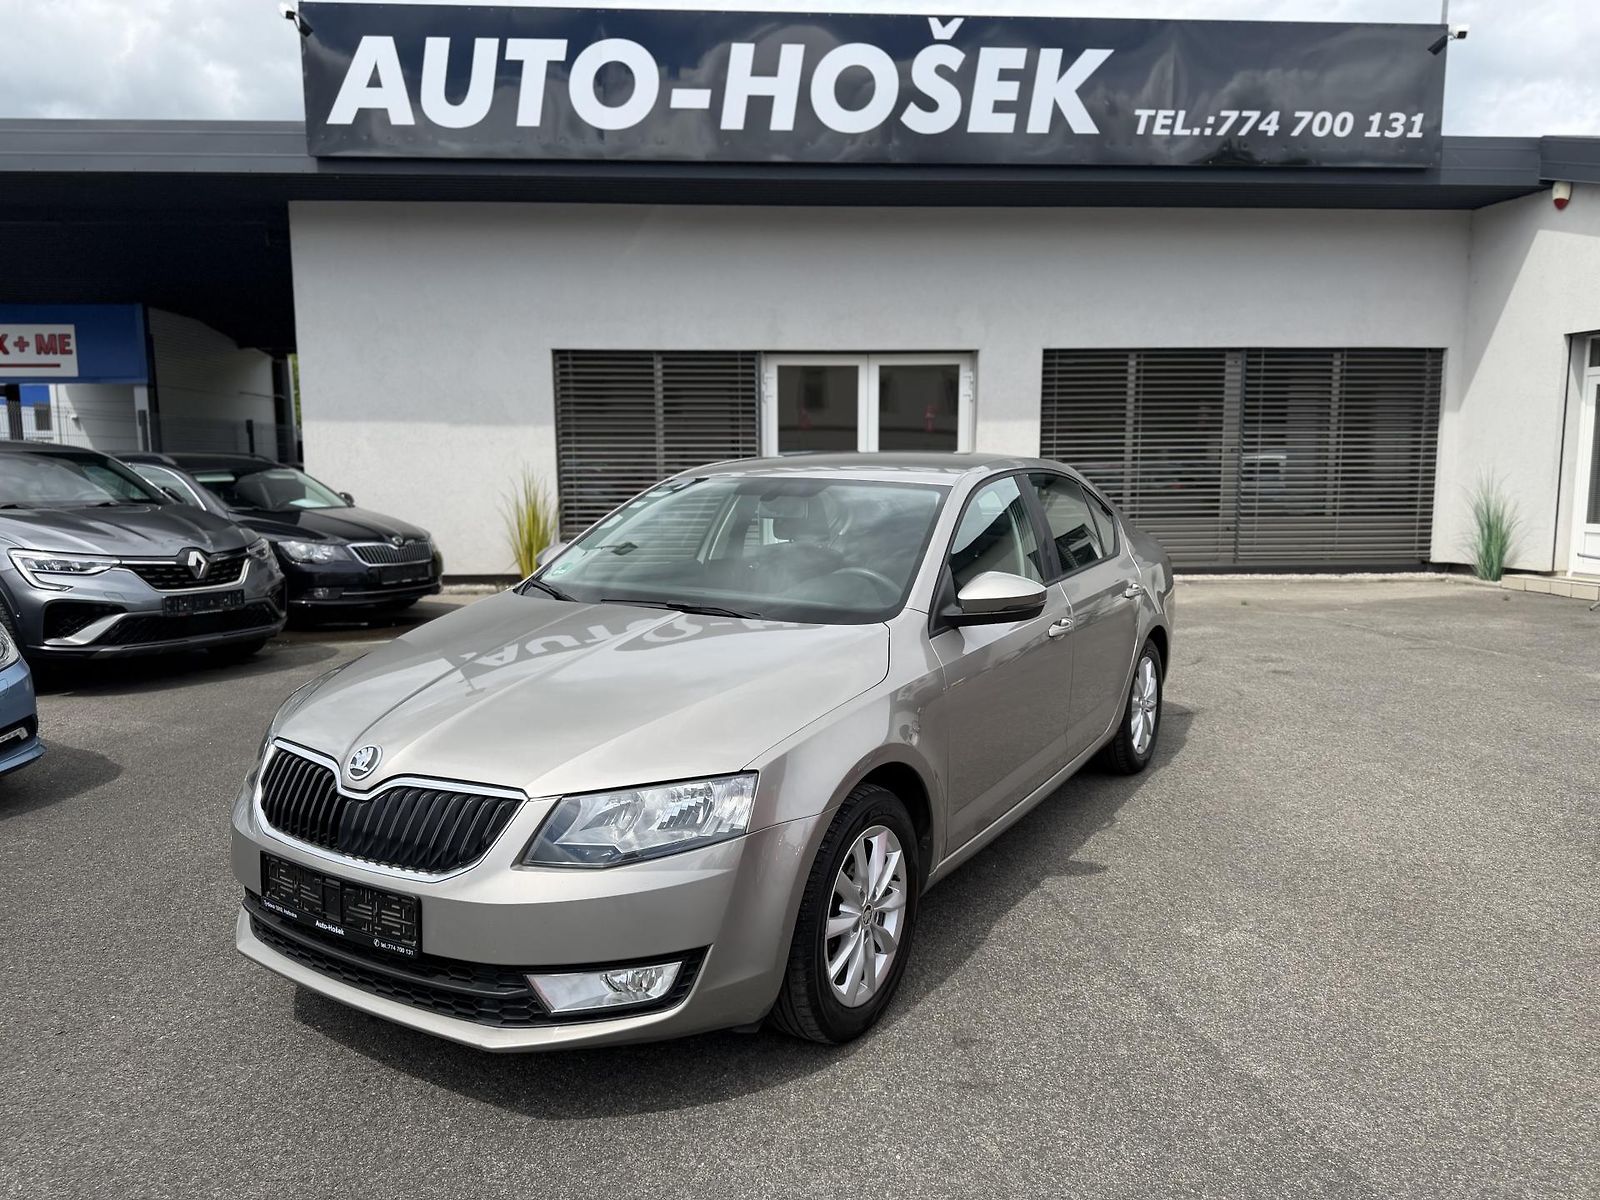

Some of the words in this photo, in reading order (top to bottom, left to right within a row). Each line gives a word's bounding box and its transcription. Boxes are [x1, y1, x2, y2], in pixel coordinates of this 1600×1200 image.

[326, 17, 1114, 136] AUTO-HOŠEK
[1134, 109, 1280, 136] TEL.:774
[1290, 111, 1354, 138] 700
[1364, 112, 1424, 138] 131
[35, 333, 73, 356] ME
